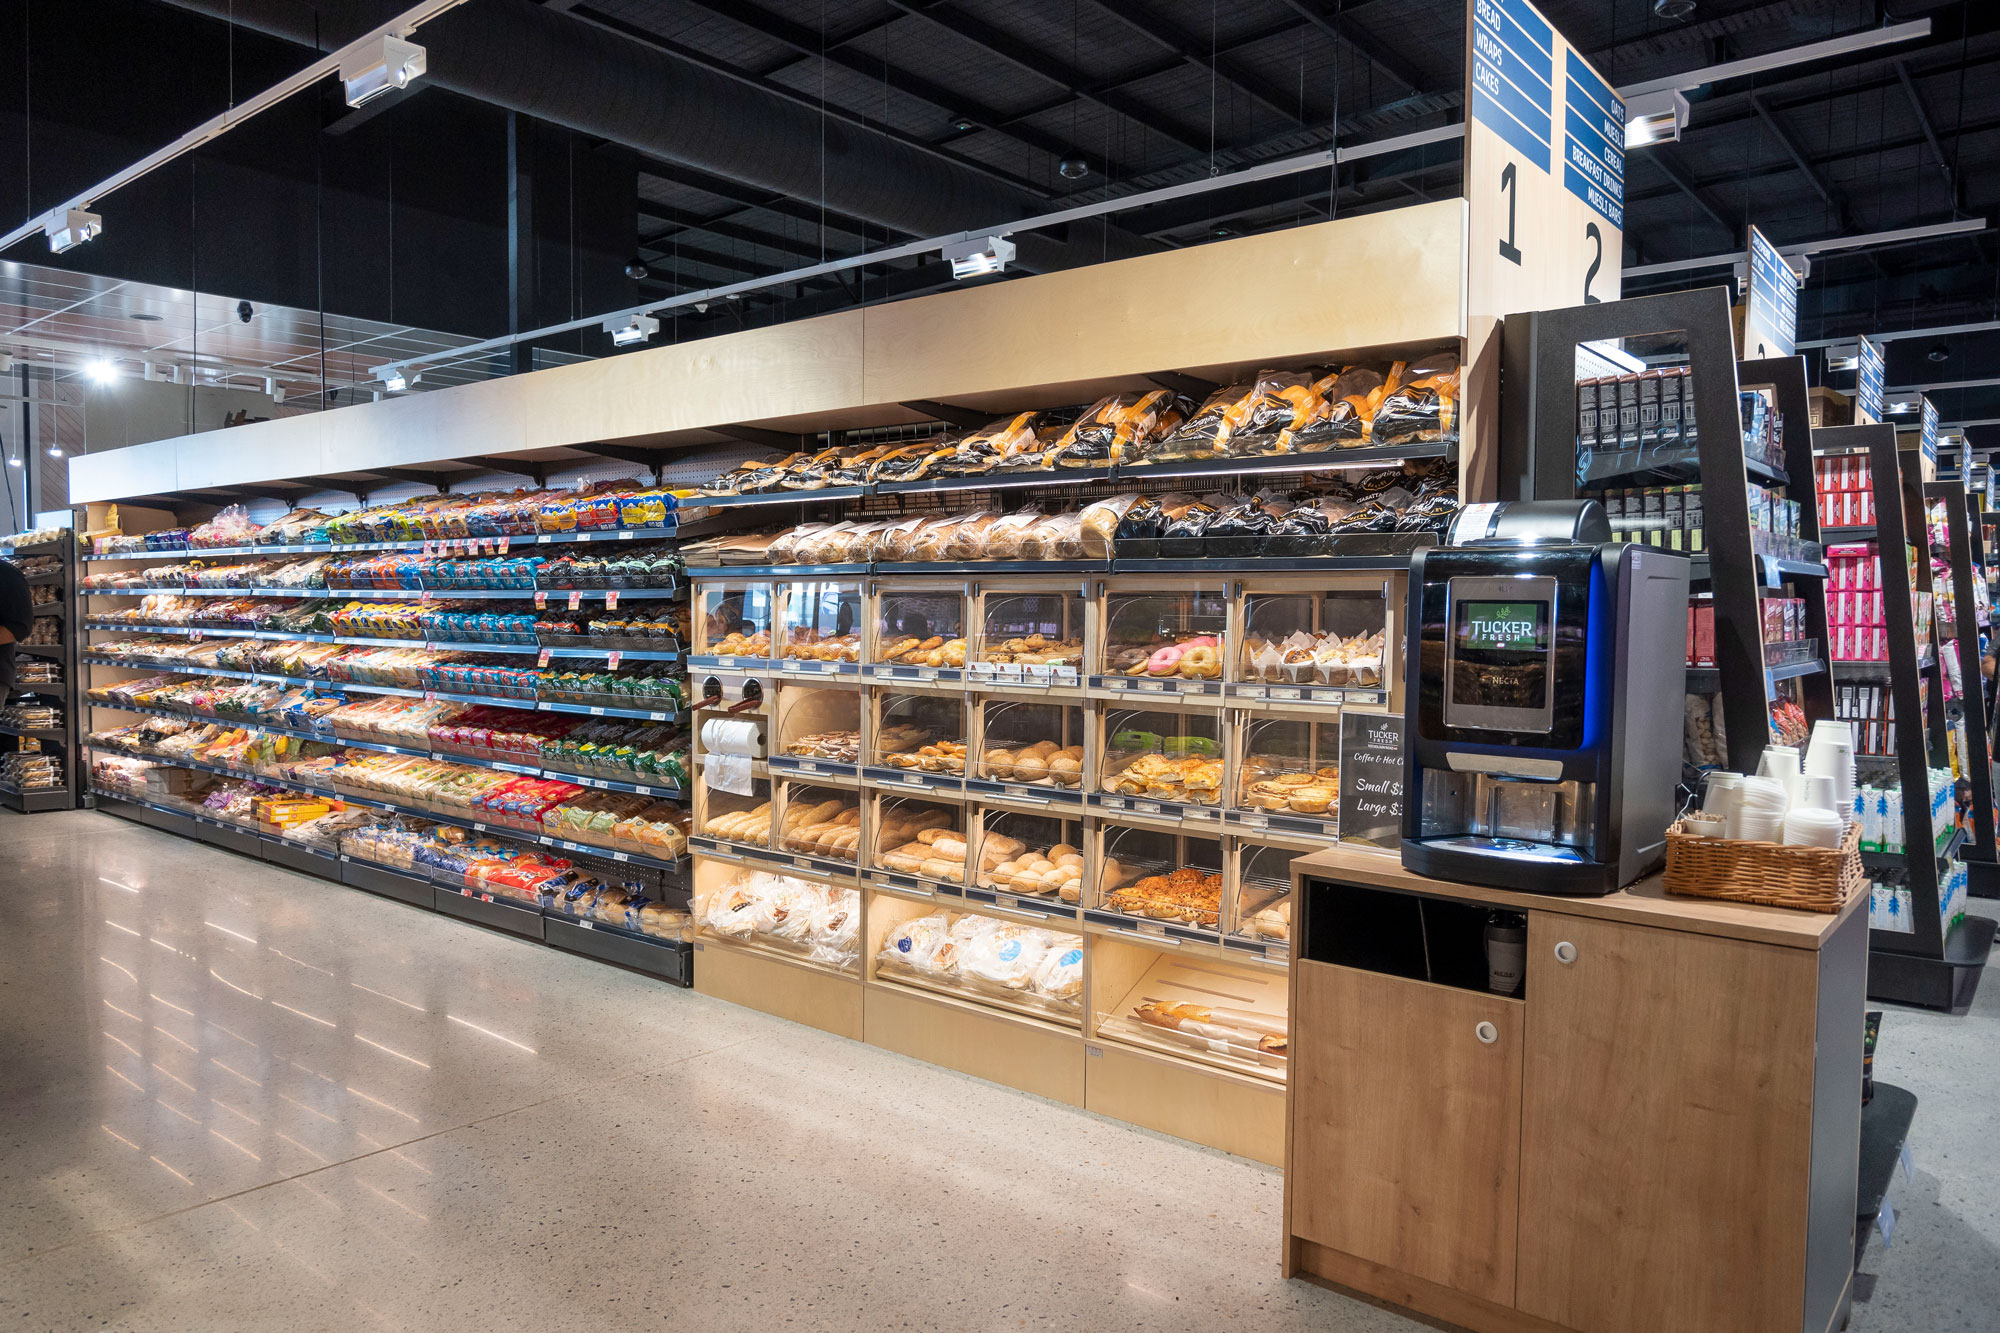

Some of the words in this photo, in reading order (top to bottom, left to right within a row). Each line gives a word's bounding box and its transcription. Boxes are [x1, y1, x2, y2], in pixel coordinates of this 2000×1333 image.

[1476, 0, 1501, 31] BREAD
[1476, 28, 1502, 66] WRAPS
[1475, 62, 1500, 95] CAKES
[1611, 99, 1624, 122] OATS
[1604, 119, 1624, 148] MUESLI
[1572, 145, 1603, 183] BREAKFAST
[1603, 167, 1622, 199] DRINKS
[1604, 146, 1623, 174] CEREAL
[1499, 162, 1522, 266] 1
[1588, 186, 1608, 213] MUESLI
[1608, 204, 1622, 225] BARS
[1584, 222, 1602, 305] 2
[1472, 621, 1532, 637] TUCKER
[1368, 730, 1399, 742] TUCKER
[1354, 753, 1374, 764] Coffee
[1376, 755, 1382, 763] &
[1383, 756, 1395, 765] Hot
[1356, 778, 1390, 794] Small
[1357, 798, 1387, 817] Large
